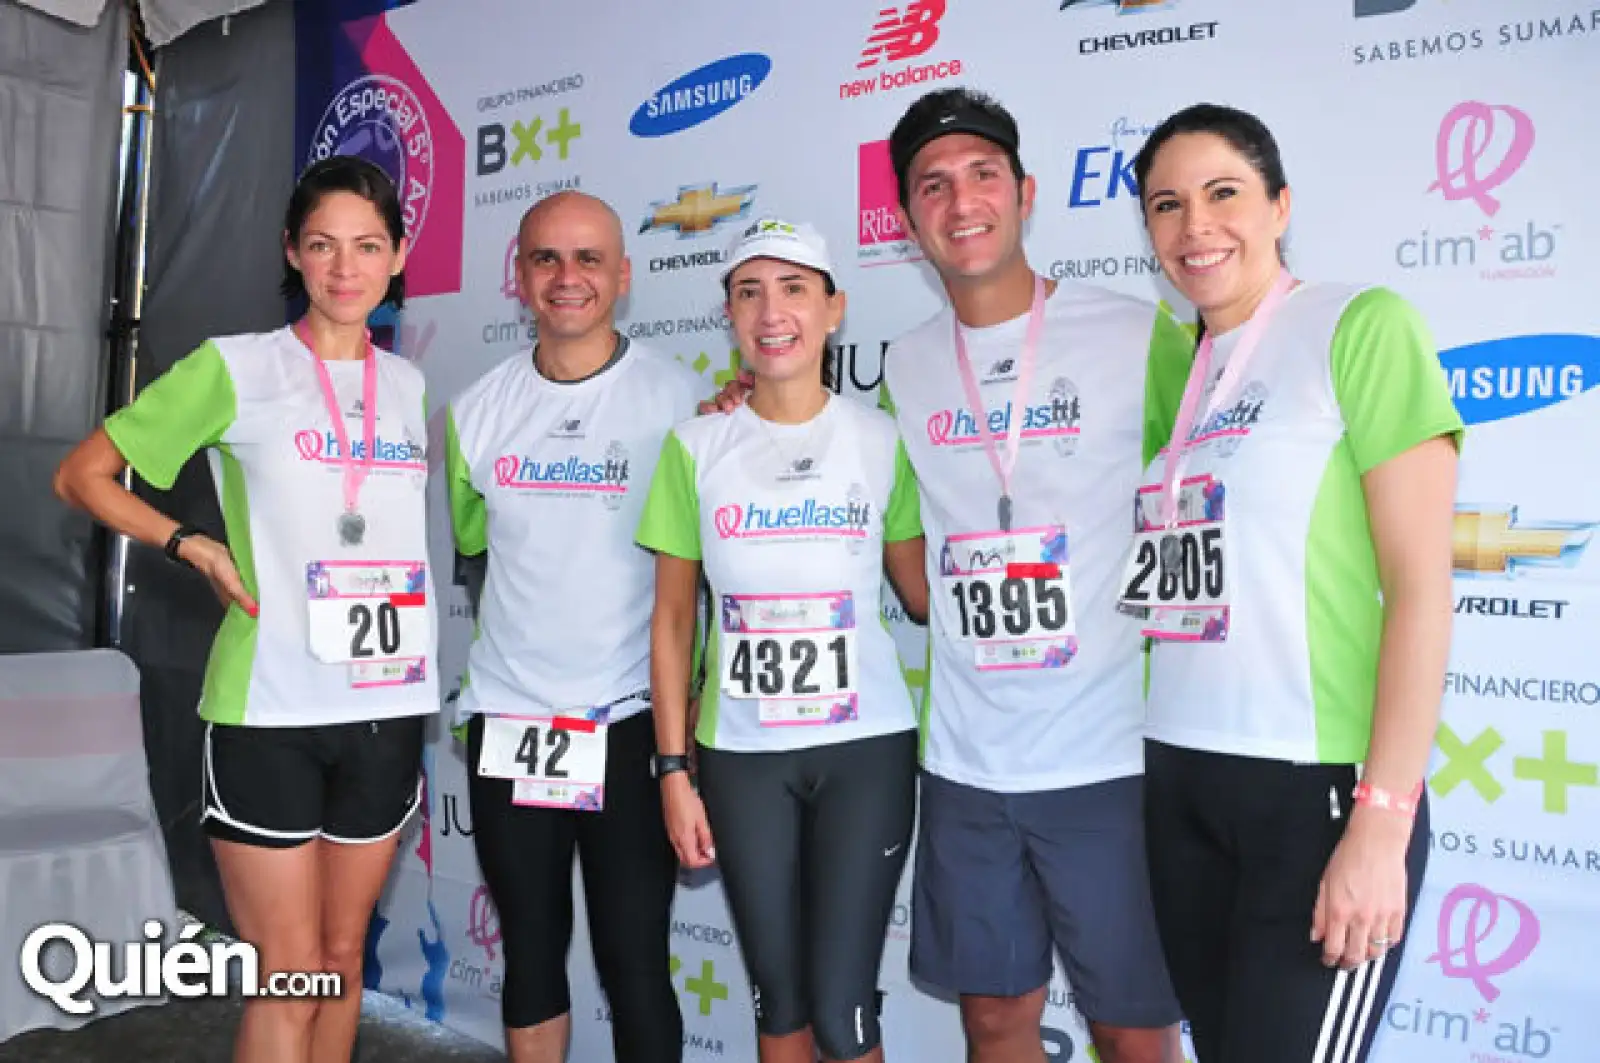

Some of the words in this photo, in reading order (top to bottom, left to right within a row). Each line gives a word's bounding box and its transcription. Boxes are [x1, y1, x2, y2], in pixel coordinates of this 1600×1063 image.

[1079, 21, 1220, 55] CHEVROLET
[1354, 29, 1483, 65] SABEMOS
[646, 74, 753, 119] SAMSUNG
[839, 79, 877, 99] new
[879, 59, 962, 90] balance
[1068, 146, 1140, 208] EK
[862, 206, 901, 245] Rib
[650, 250, 728, 273] CHEVROL
[1050, 257, 1119, 279] GRUPO
[1124, 254, 1162, 276] FIN
[677, 314, 735, 334] FINANC
[519, 454, 606, 482] huellas
[744, 498, 848, 529] huellas
[951, 569, 1068, 638] 1395
[347, 602, 401, 658] 20
[729, 635, 848, 695] 4321
[1443, 671, 1600, 705] FINANCIERO
[514, 724, 571, 778] 42
